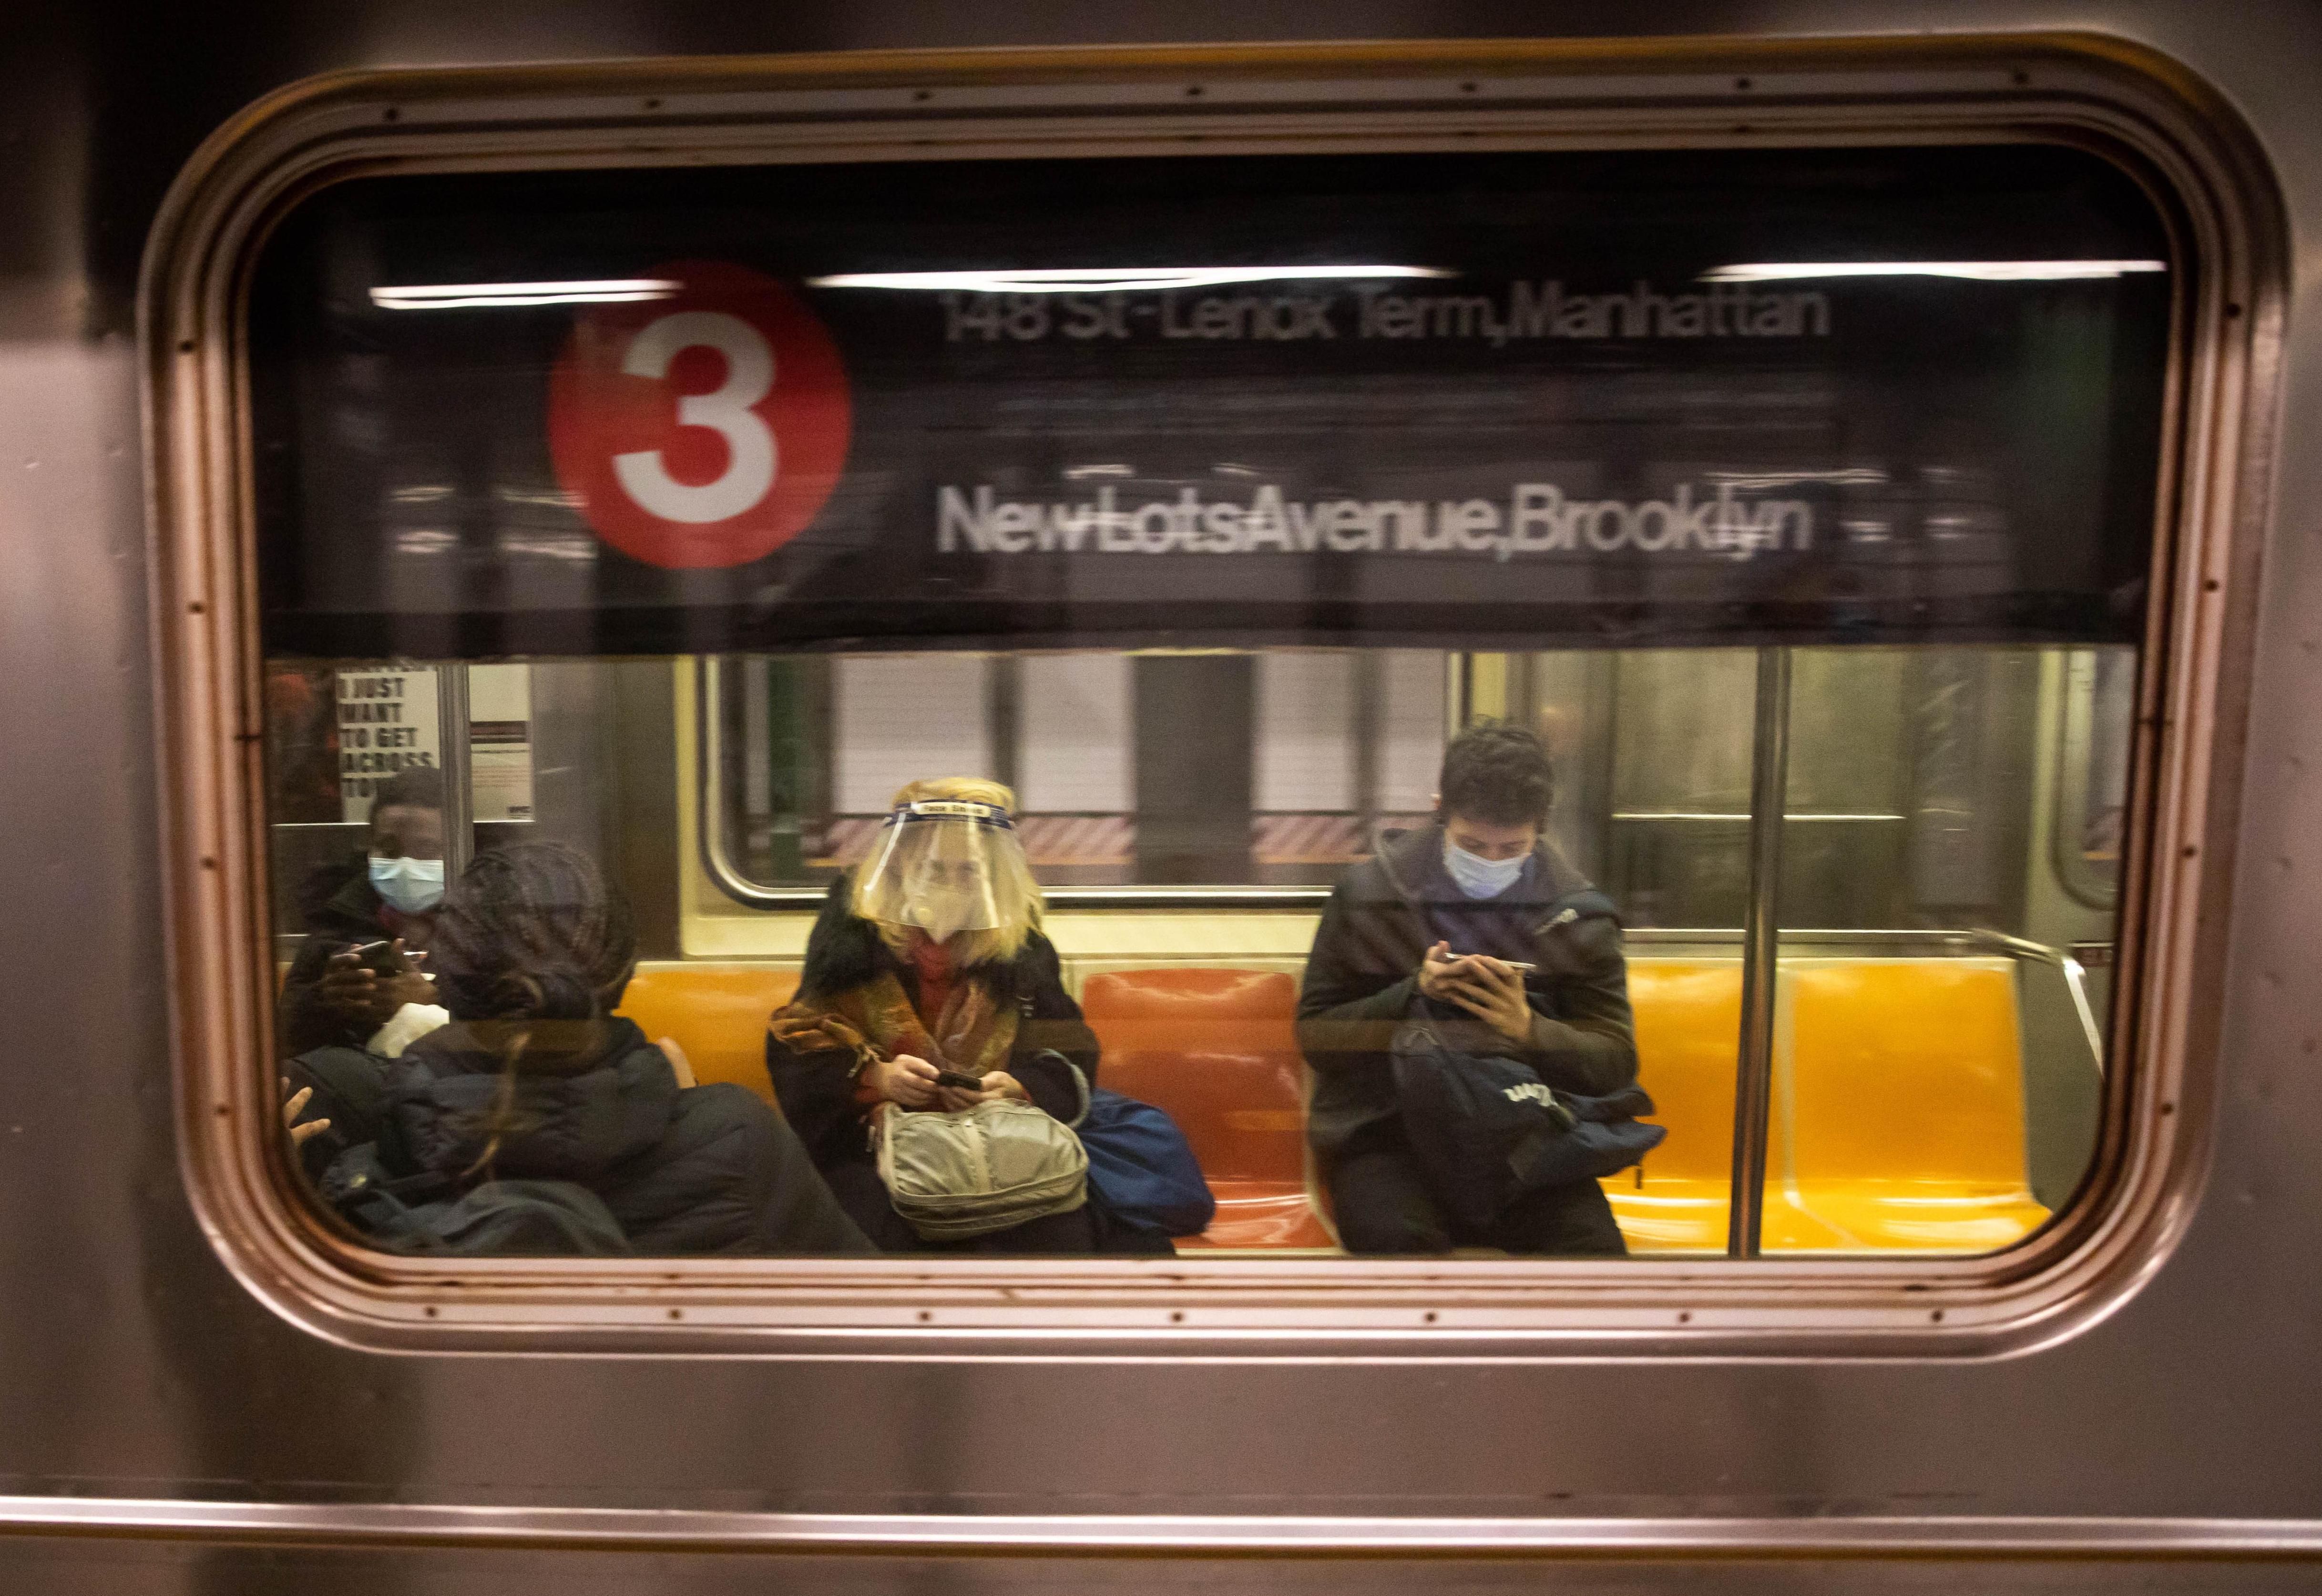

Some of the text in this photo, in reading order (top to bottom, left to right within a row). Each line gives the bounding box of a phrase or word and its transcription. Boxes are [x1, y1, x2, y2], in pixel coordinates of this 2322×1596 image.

[938, 288, 1051, 341] 148
[613, 310, 778, 523] 3
[338, 727, 417, 748] TO GET
